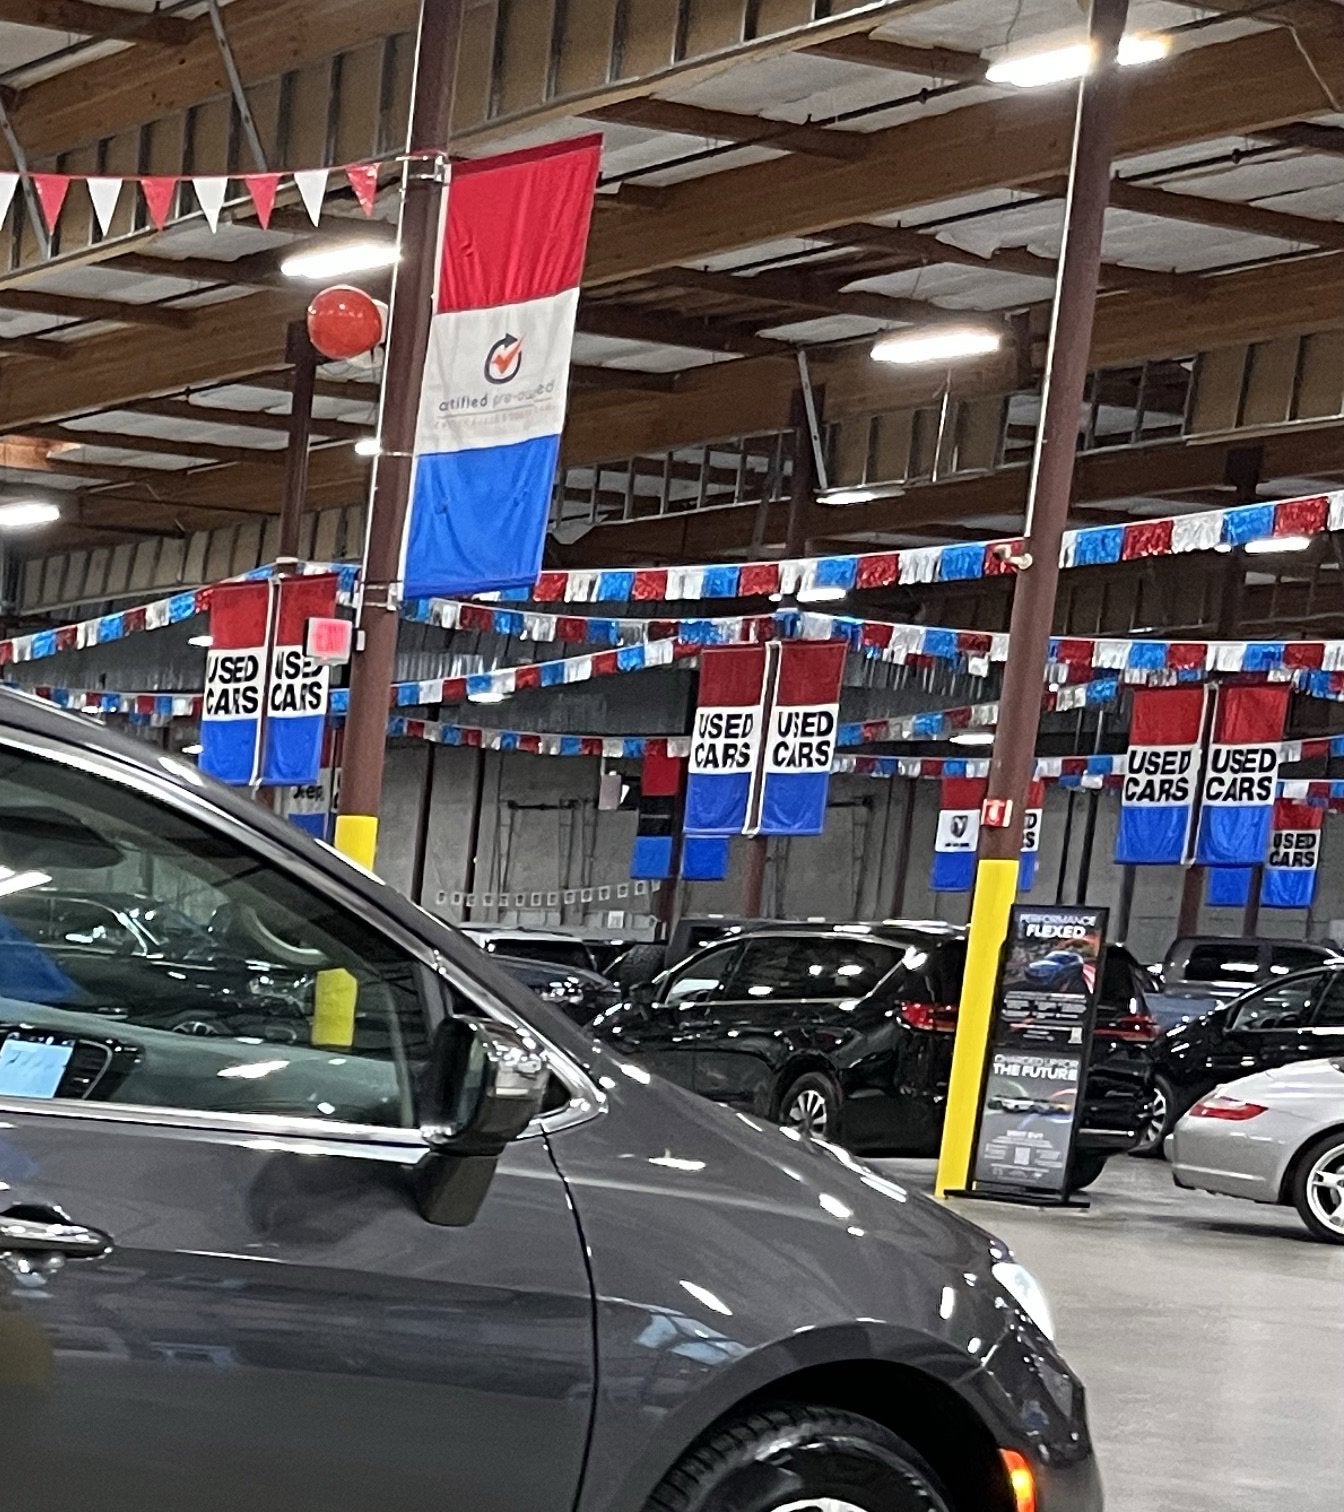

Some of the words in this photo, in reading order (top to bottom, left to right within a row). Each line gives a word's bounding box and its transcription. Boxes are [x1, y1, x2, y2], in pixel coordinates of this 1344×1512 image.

[698, 713, 754, 739] USED
[777, 710, 834, 738] USED
[694, 742, 751, 768] CARS
[772, 740, 831, 767] CARS
[1128, 750, 1192, 775] USED
[1211, 748, 1277, 774] USED
[1124, 777, 1189, 802] CARS
[1205, 776, 1273, 802] CARS
[1272, 832, 1316, 850] USED
[1269, 851, 1315, 867] CARS
[1026, 923, 1086, 938] FLEXED
[993, 1062, 1019, 1077] THE
[1022, 1064, 1078, 1081] FUTURE
